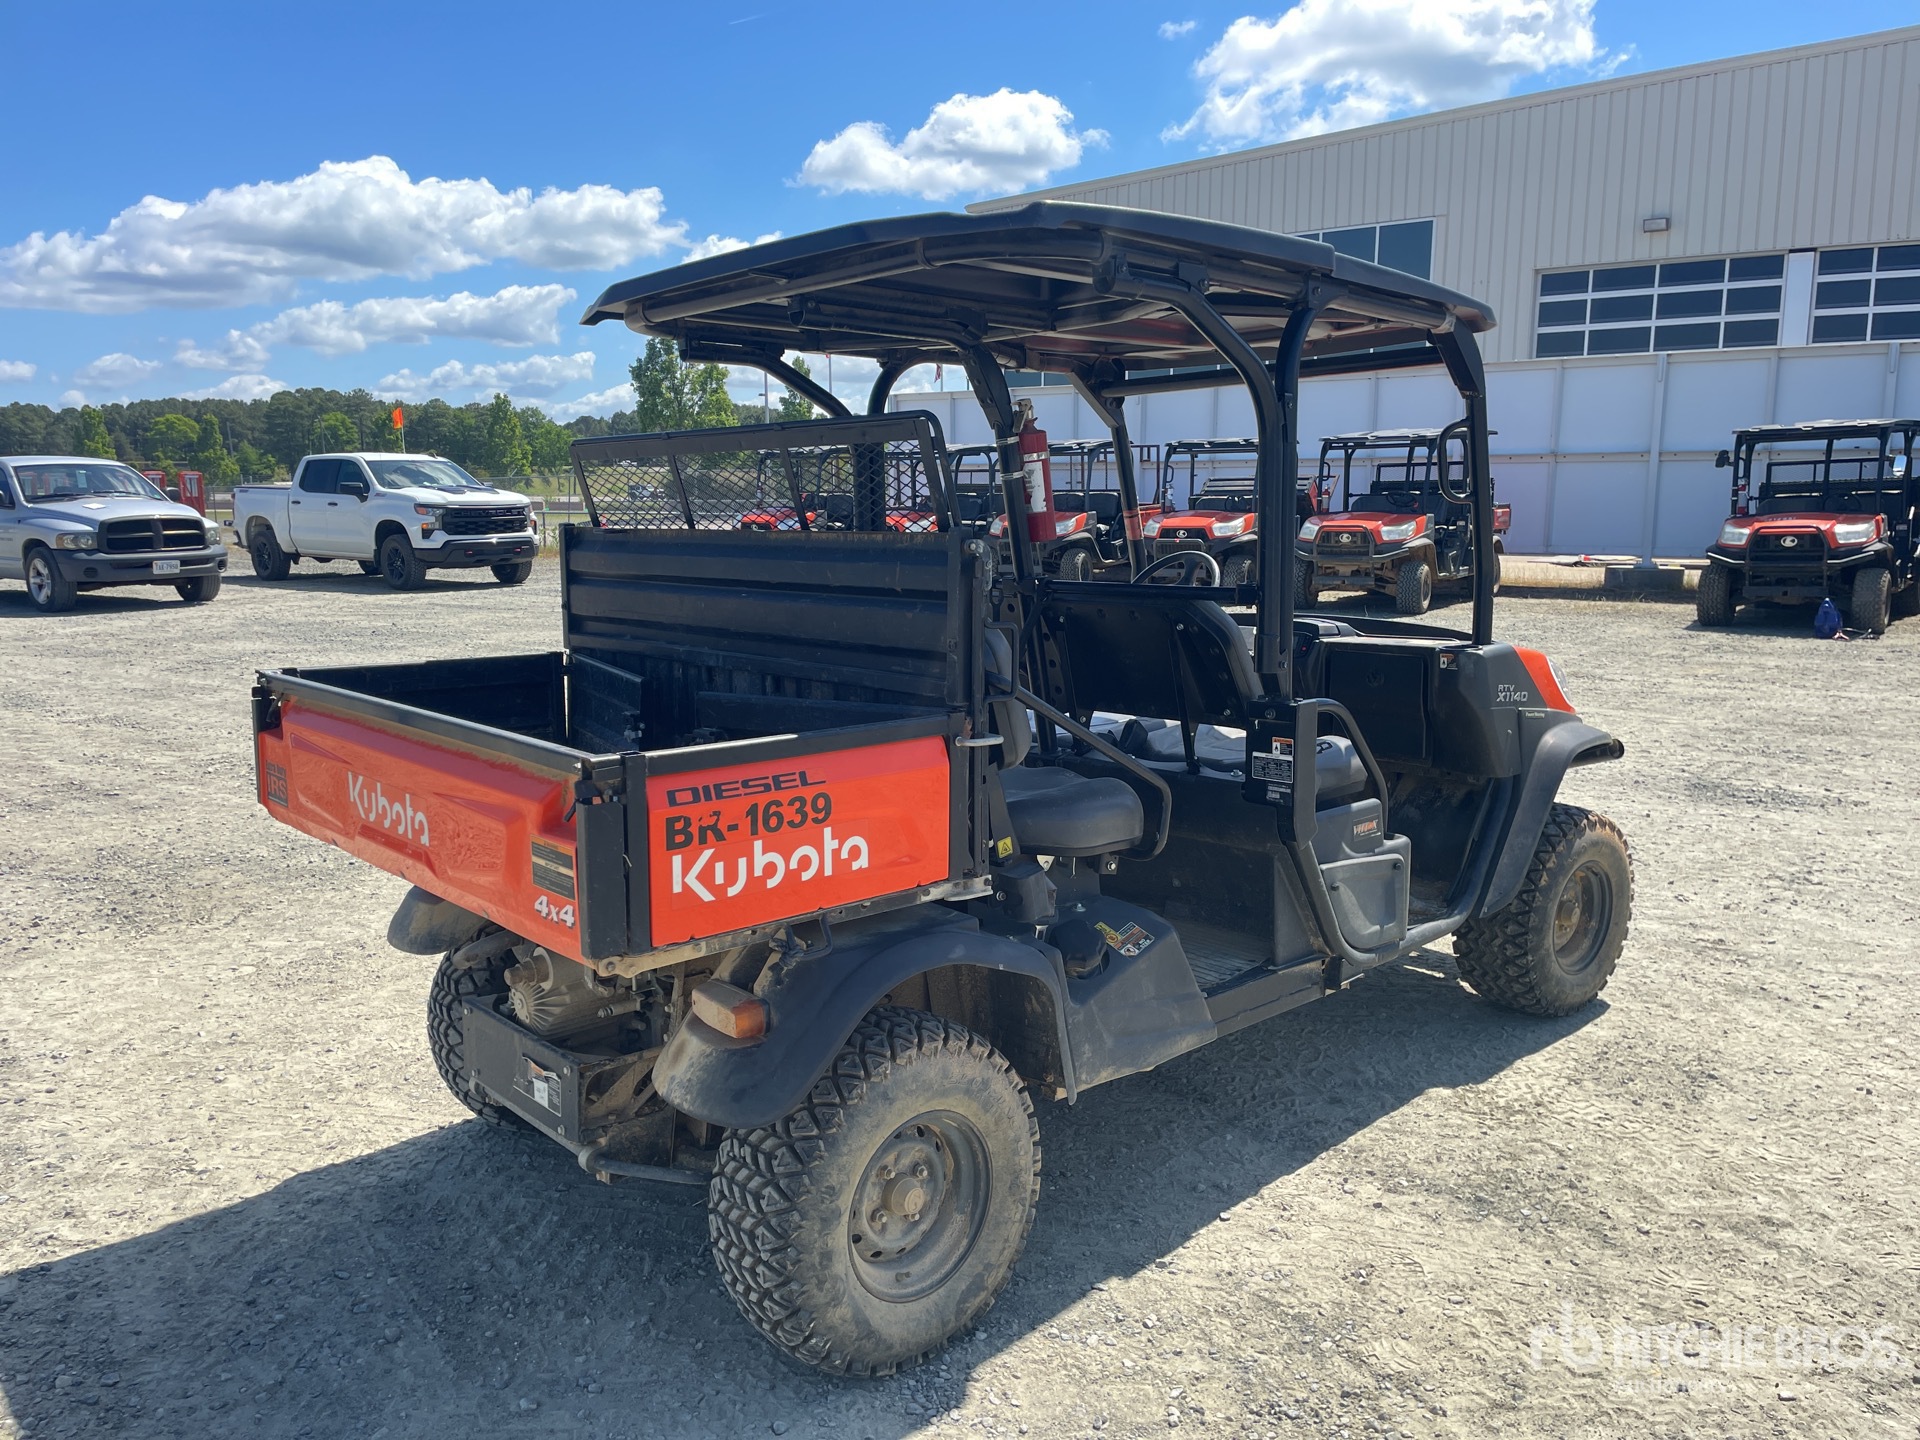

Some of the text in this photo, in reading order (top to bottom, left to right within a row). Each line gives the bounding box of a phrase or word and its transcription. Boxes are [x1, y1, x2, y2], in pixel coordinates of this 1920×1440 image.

[1497, 684, 1515, 692] RTV
[268, 773, 288, 800] IRS
[666, 770, 827, 808] DIESEL
[347, 771, 430, 847] Kubota
[671, 826, 869, 902] Kubota
[534, 894, 576, 929] 4x4
